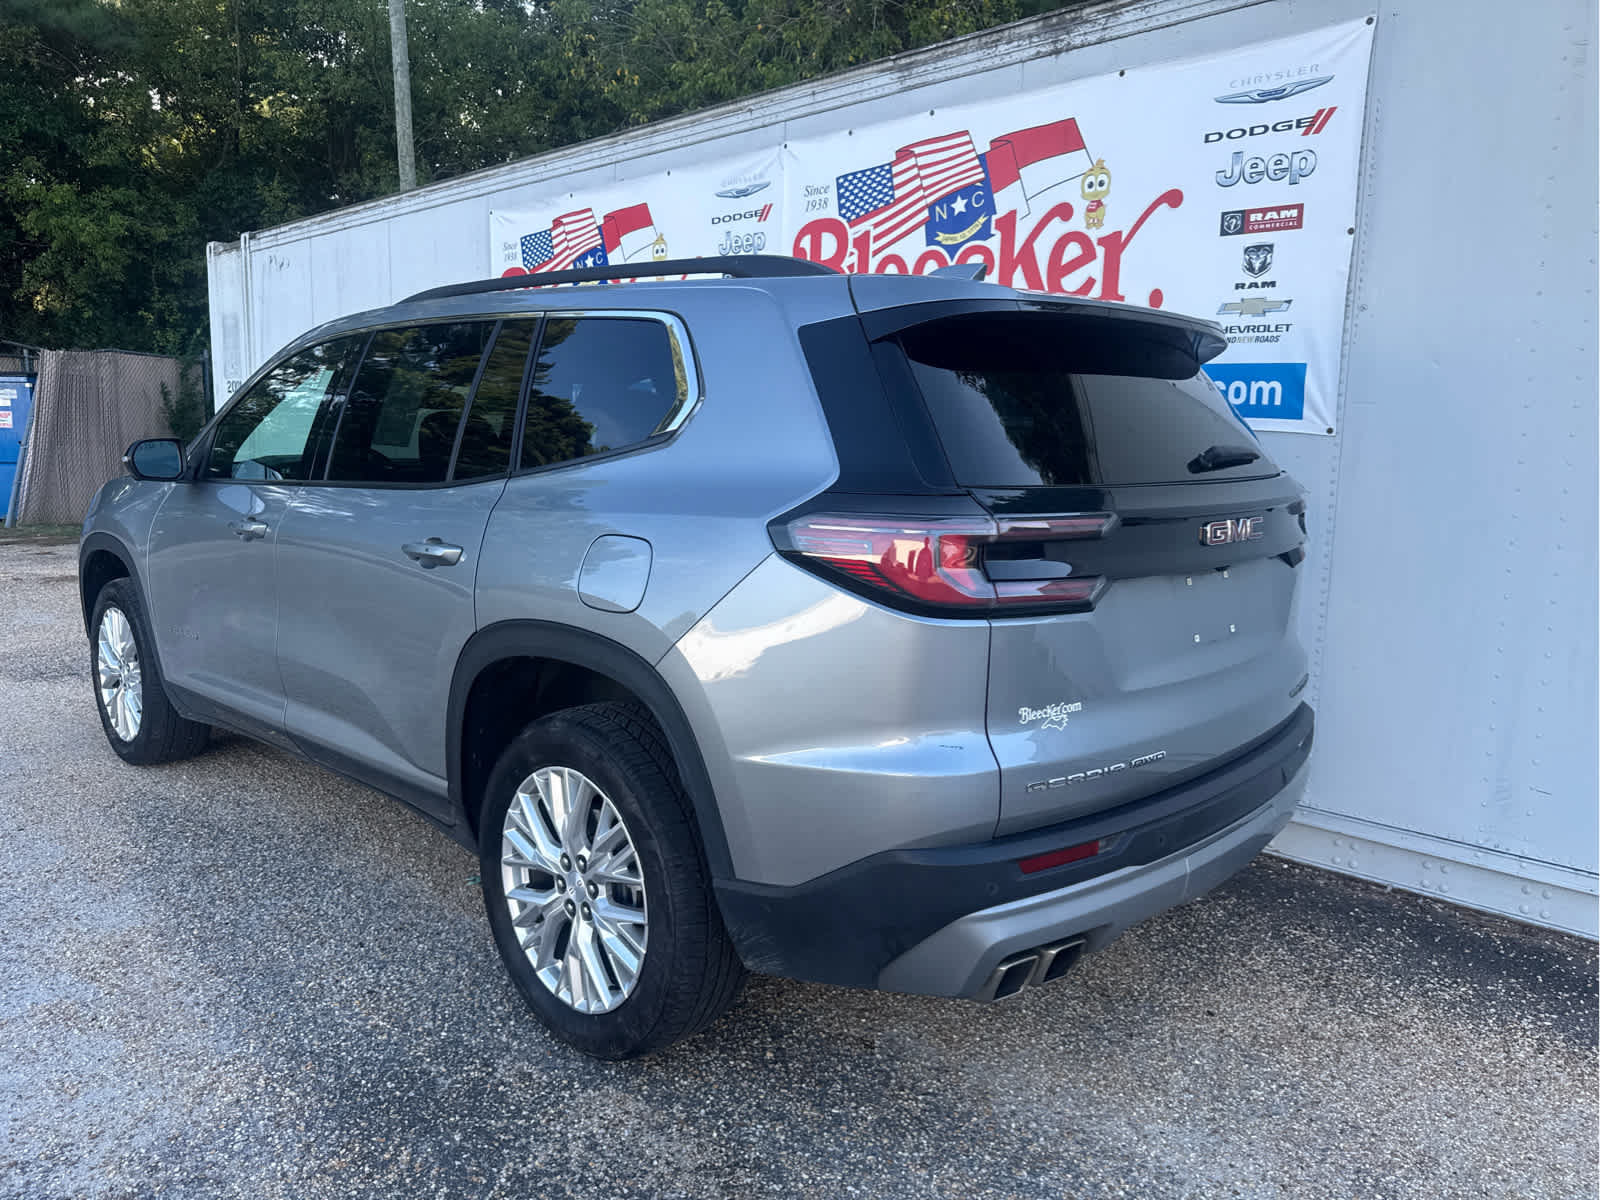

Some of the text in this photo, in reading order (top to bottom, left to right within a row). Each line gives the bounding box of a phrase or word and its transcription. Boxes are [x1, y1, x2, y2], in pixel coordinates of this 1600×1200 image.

[1229, 63, 1320, 89] CHRYSLER
[1204, 115, 1316, 143] DODGE
[1215, 149, 1317, 188] Jeep
[804, 183, 830, 198] Since
[805, 197, 828, 213] 1938
[935, 191, 985, 222] N C
[711, 208, 764, 225] DODGE
[1249, 208, 1299, 221] RAM
[1249, 221, 1298, 230] COMMERCIAL
[719, 231, 766, 256] Jeep
[1234, 280, 1277, 290] RAM
[1223, 323, 1293, 335] HEVROLET
[1203, 516, 1264, 546] GMC
